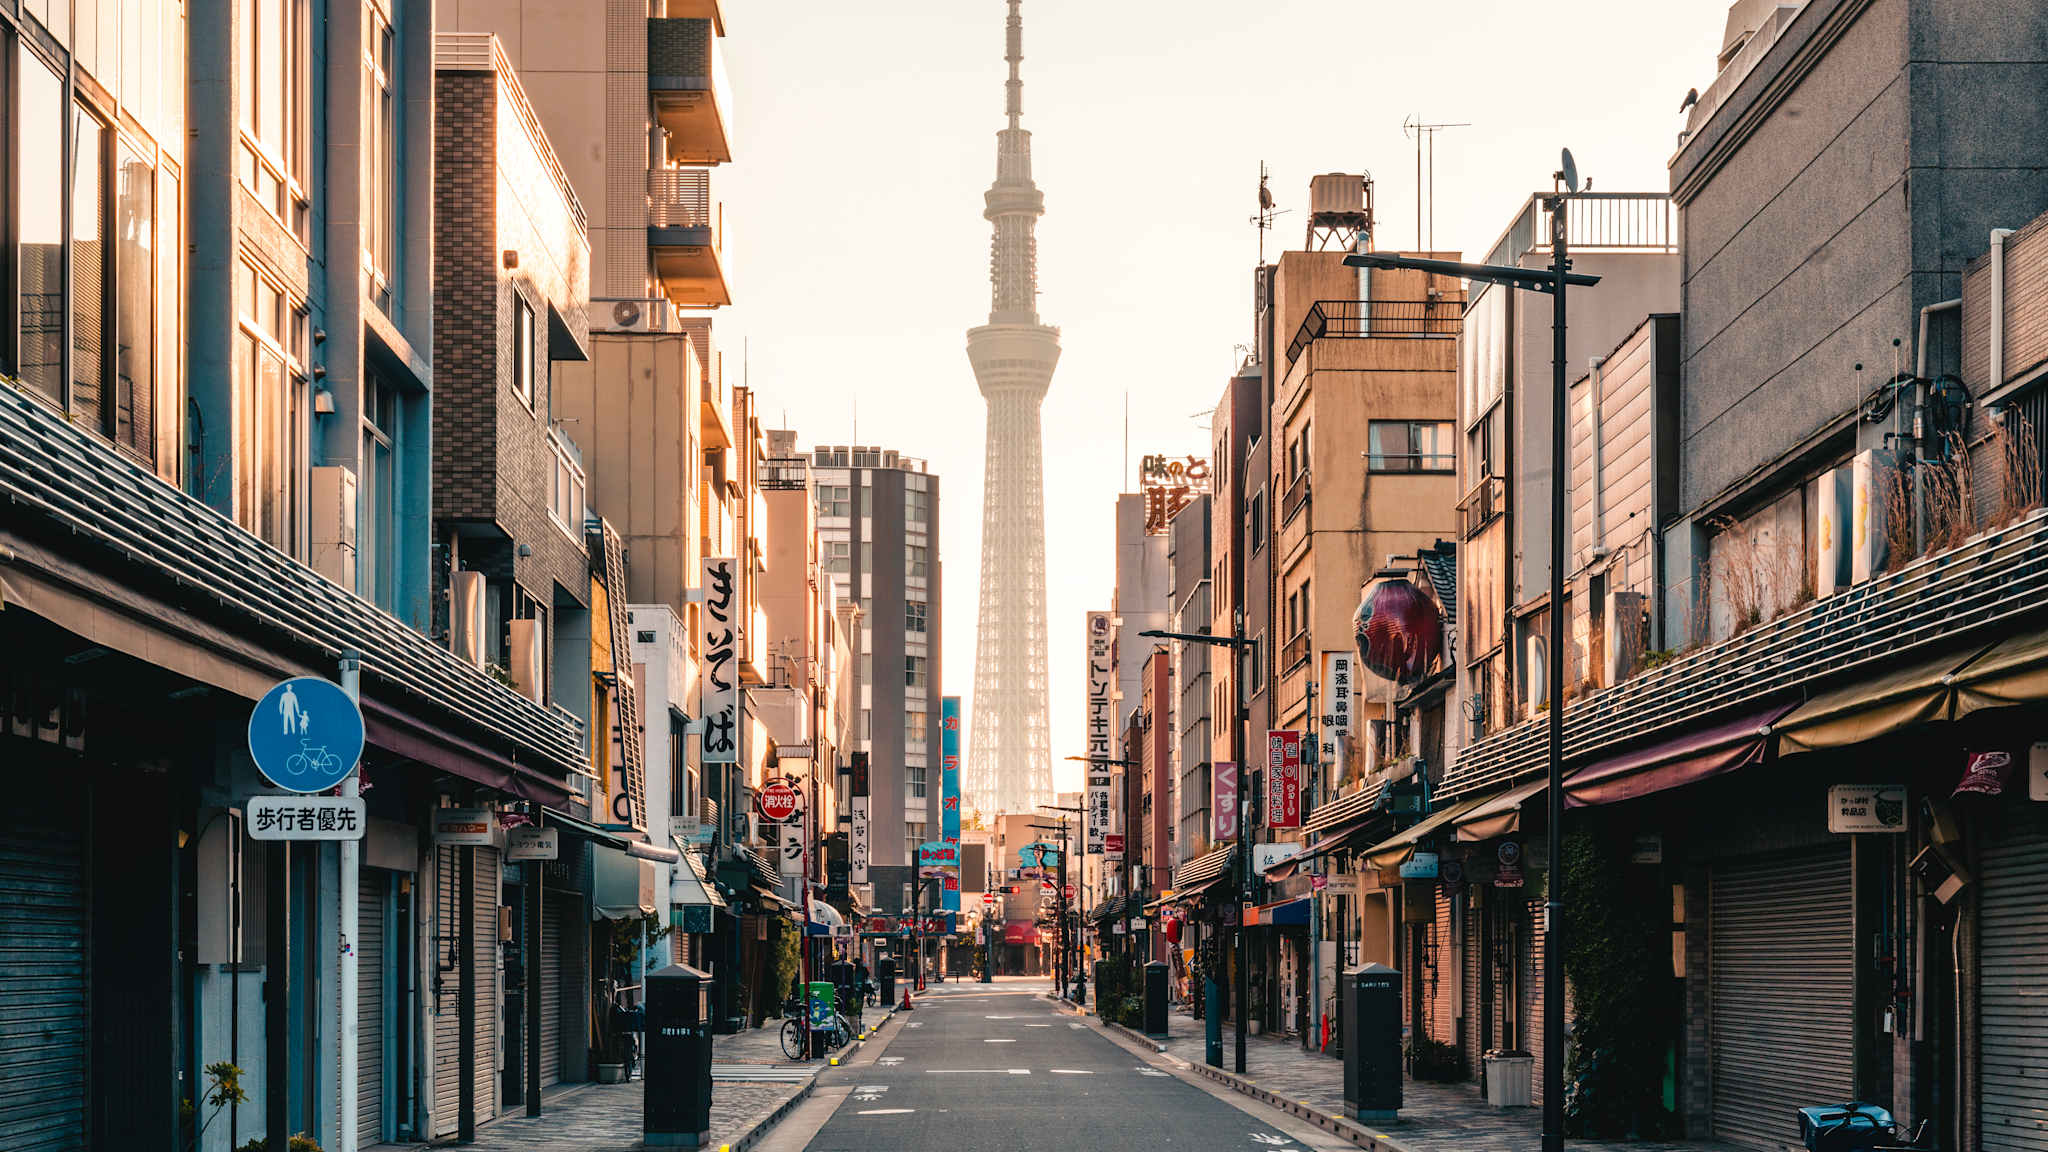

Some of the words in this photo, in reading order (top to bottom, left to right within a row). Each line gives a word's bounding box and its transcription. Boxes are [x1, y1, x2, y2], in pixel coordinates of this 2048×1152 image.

[1144, 454, 1211, 479] 味のと
[1090, 660, 1108, 772] トンテキ元気
[765, 795, 793, 808] 消火栓
[1217, 767, 1237, 836] くすり
[1271, 737, 1283, 823] 韓国家庭料理
[257, 807, 356, 831] 歩行者優先
